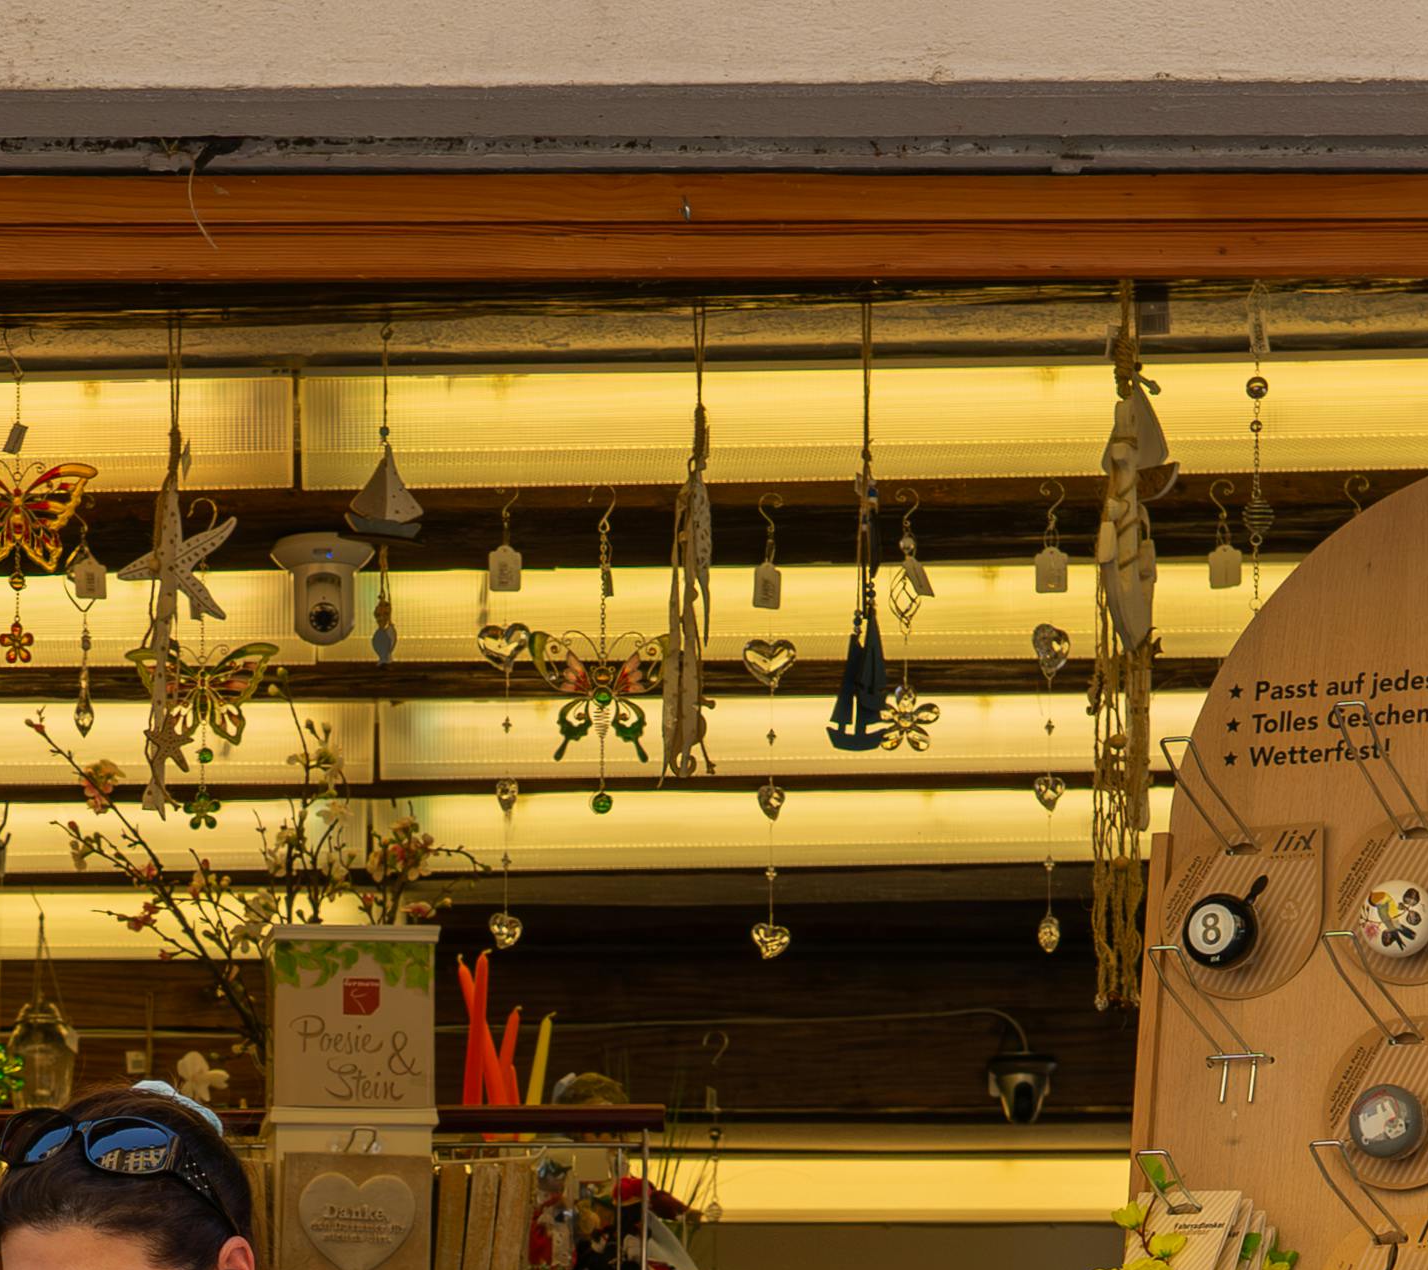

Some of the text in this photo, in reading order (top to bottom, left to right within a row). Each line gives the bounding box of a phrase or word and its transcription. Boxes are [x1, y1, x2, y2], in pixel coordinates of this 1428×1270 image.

[1254, 675, 1318, 703] Passt
[1324, 669, 1367, 698] auf
[1252, 708, 1318, 734] Tolles
[1248, 737, 1392, 769] Wetterfest!
[1202, 912, 1222, 945] 8
[289, 1015, 422, 1078] Poesie &
[325, 1060, 404, 1102] Stein
